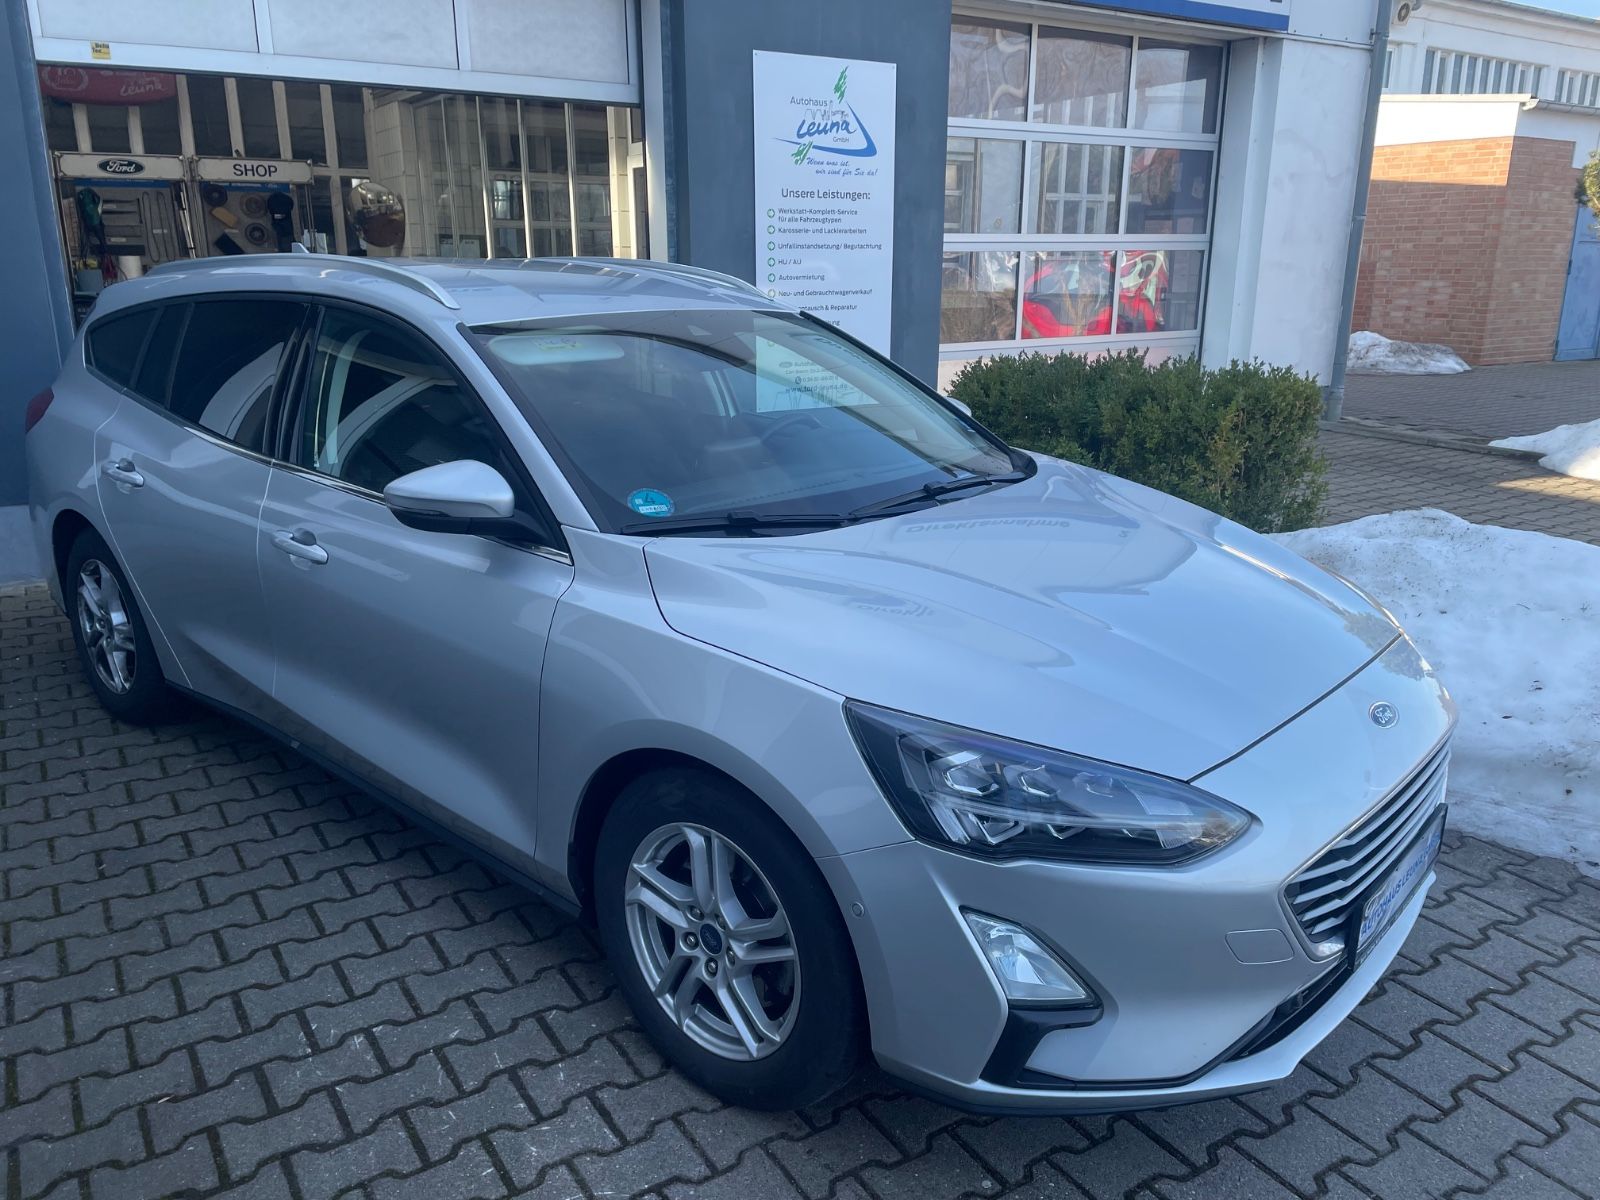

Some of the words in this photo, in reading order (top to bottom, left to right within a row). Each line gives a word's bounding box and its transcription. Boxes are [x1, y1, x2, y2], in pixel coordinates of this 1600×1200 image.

[790, 96, 828, 107] Autohaus
[806, 156, 824, 166] Wenn
[105, 159, 137, 174] Ford
[233, 163, 278, 178] SHOP
[827, 167, 841, 175] sind
[842, 167, 852, 177] für
[854, 168, 865, 176] Sie
[866, 168, 878, 176] da!
[781, 188, 815, 199] Unsere
[817, 189, 871, 201] Leistungen:
[778, 208, 858, 217] Werkstatt-Komplett-Service
[823, 227, 867, 235] Lackierarbeiten
[805, 288, 873, 298] Gebrauchtwagenverkauf
